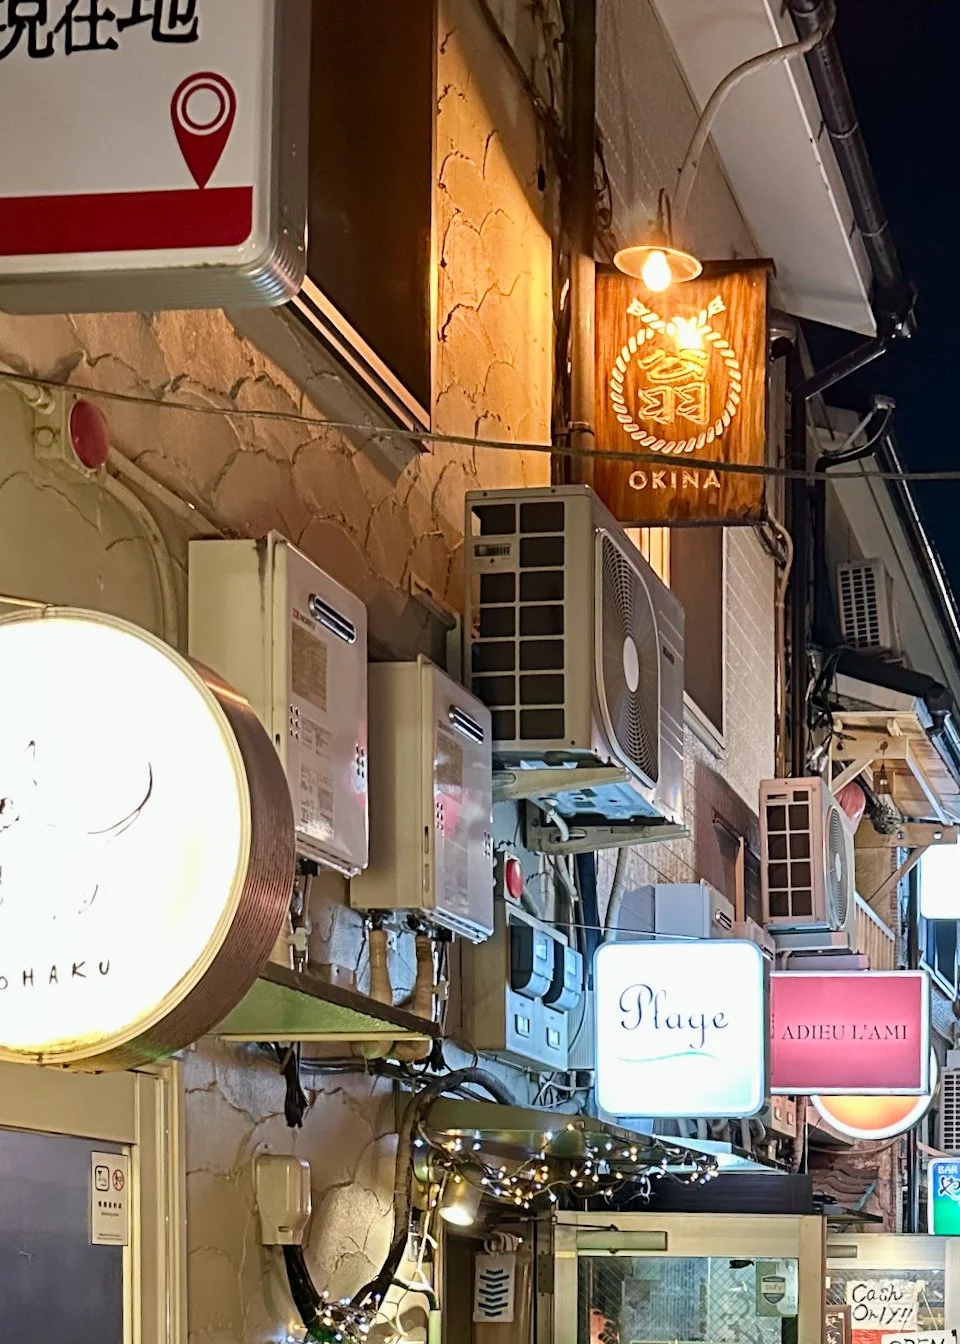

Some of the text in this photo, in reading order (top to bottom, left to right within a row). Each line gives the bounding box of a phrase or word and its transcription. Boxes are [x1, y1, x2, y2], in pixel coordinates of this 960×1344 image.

[629, 470, 721, 490] OKINA
[619, 983, 729, 1050] Plage
[782, 1024, 909, 1040] ADIEU L'AMI
[937, 1165, 958, 1174] BAR
[852, 1283, 904, 1303] Cash
